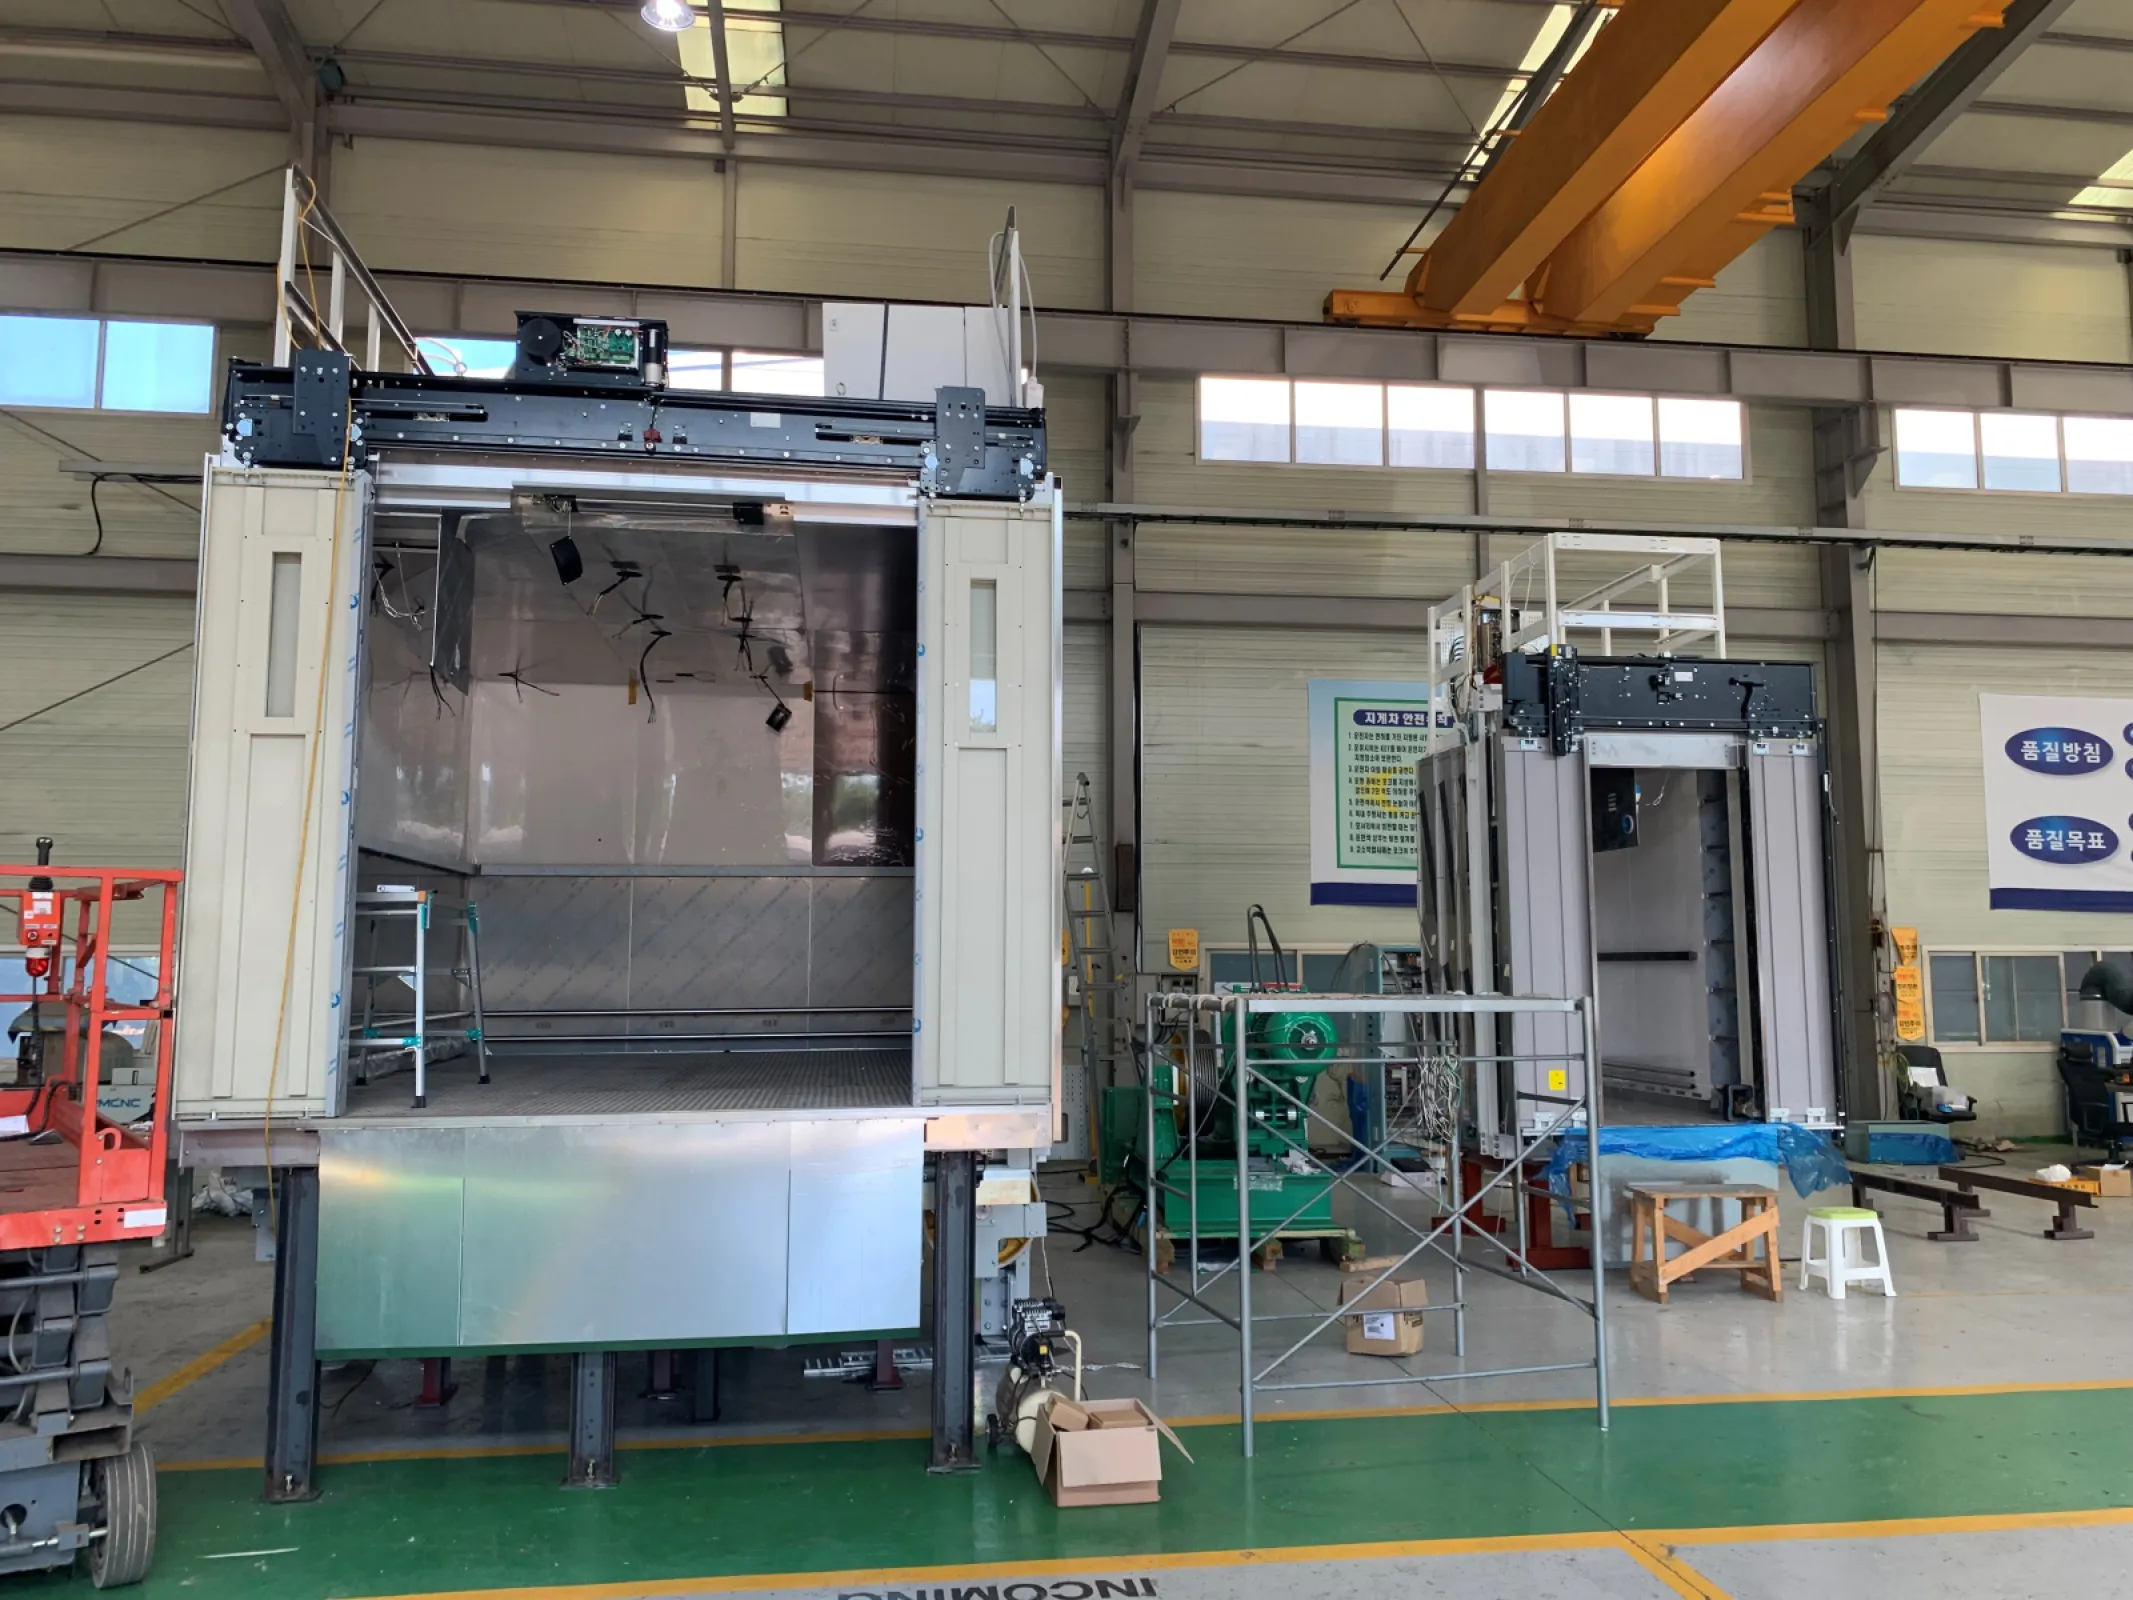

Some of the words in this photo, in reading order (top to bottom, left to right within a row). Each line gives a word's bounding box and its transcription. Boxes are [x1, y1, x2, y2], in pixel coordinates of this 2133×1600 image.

[1403, 712, 1448, 726] 안전칙
[2020, 740, 2101, 764] 품질방침
[2024, 828, 2107, 852] 품질목표
